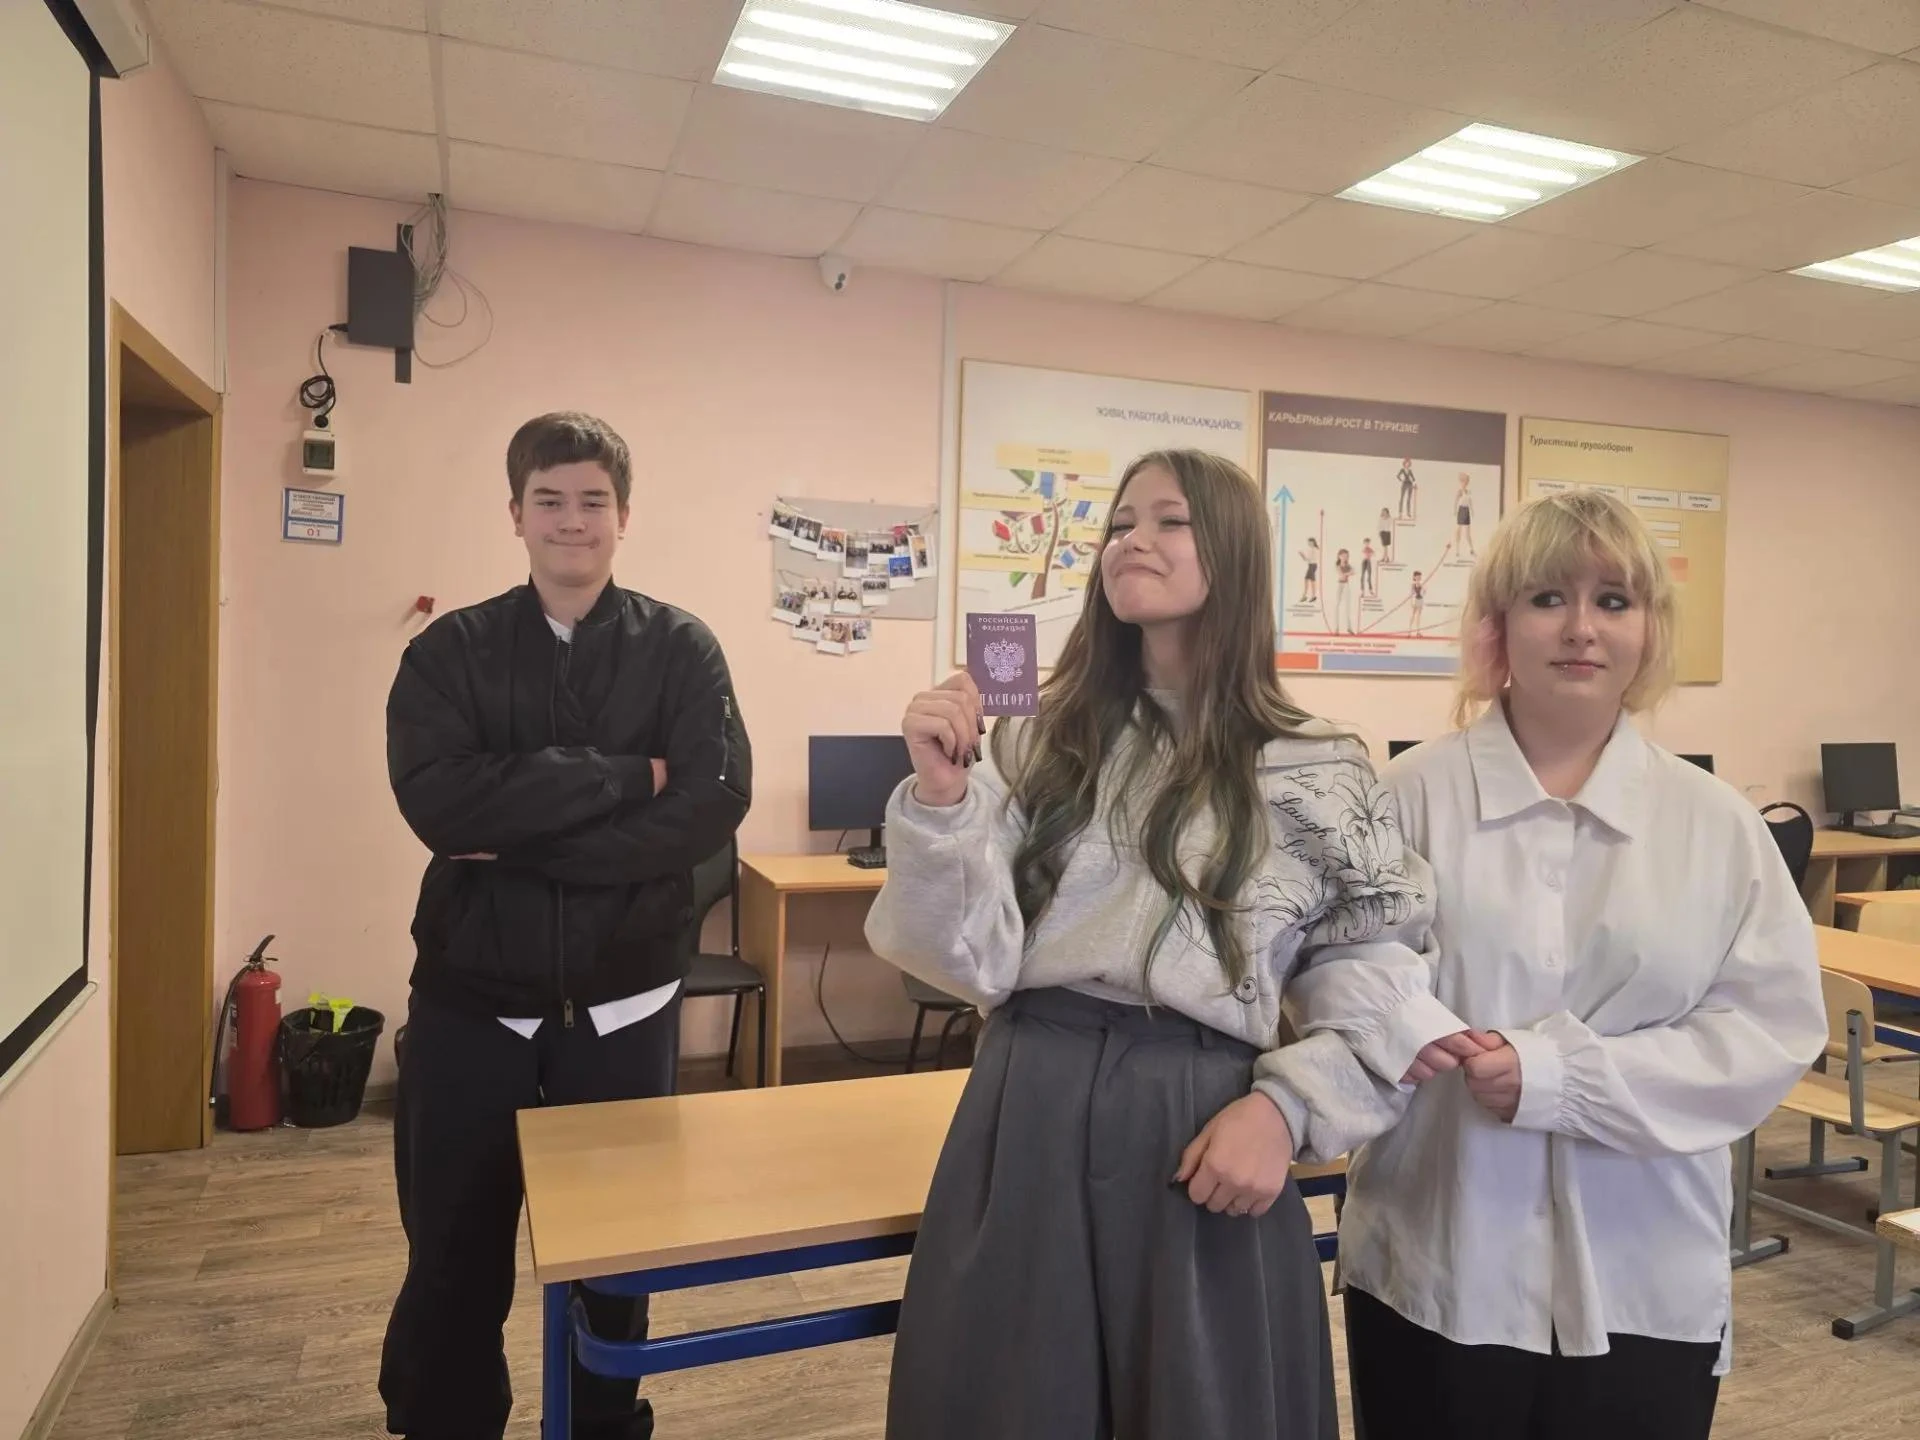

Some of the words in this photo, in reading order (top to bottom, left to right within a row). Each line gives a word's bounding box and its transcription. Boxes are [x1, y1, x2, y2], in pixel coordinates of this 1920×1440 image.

[1267, 411, 1333, 426] КАРЬЕРНЫЙ
[1334, 417, 1361, 429] РОСТ
[1364, 420, 1371, 429] В
[1374, 420, 1420, 434] ТУРИЗМЕ
[1530, 435, 1578, 449] Туристский
[978, 616, 1029, 624] РОССИЙСКАЯ
[979, 693, 1033, 706] ПАСПОРТ
[1284, 768, 1326, 799] Live
[1269, 791, 1337, 840] Laugh
[1275, 832, 1319, 867] Love
